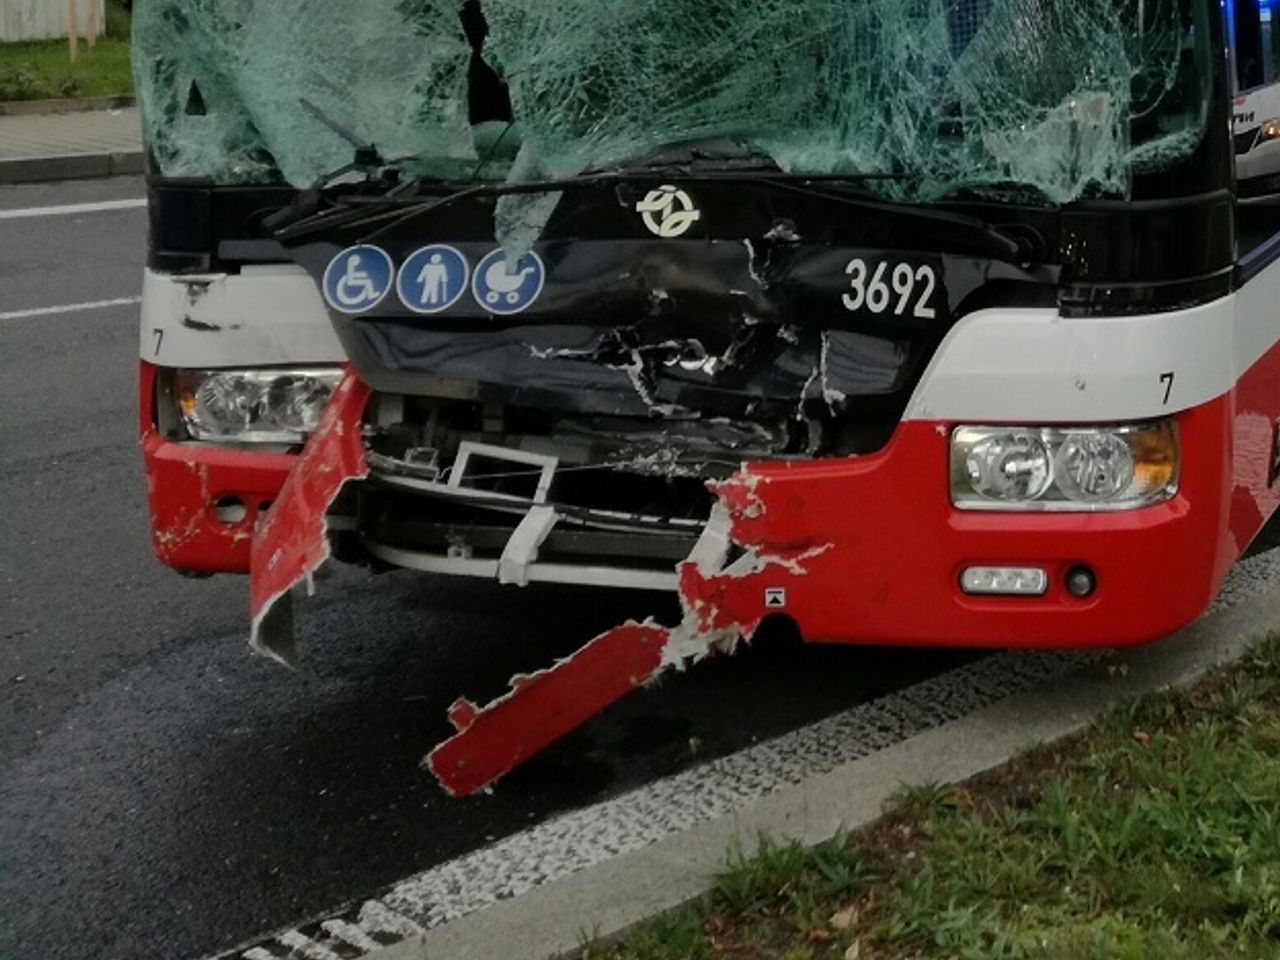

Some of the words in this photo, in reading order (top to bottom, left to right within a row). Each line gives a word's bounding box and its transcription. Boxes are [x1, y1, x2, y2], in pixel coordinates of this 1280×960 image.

[841, 258, 937, 320] 3692
[153, 328, 164, 356] 7
[1159, 372, 1175, 406] 7
